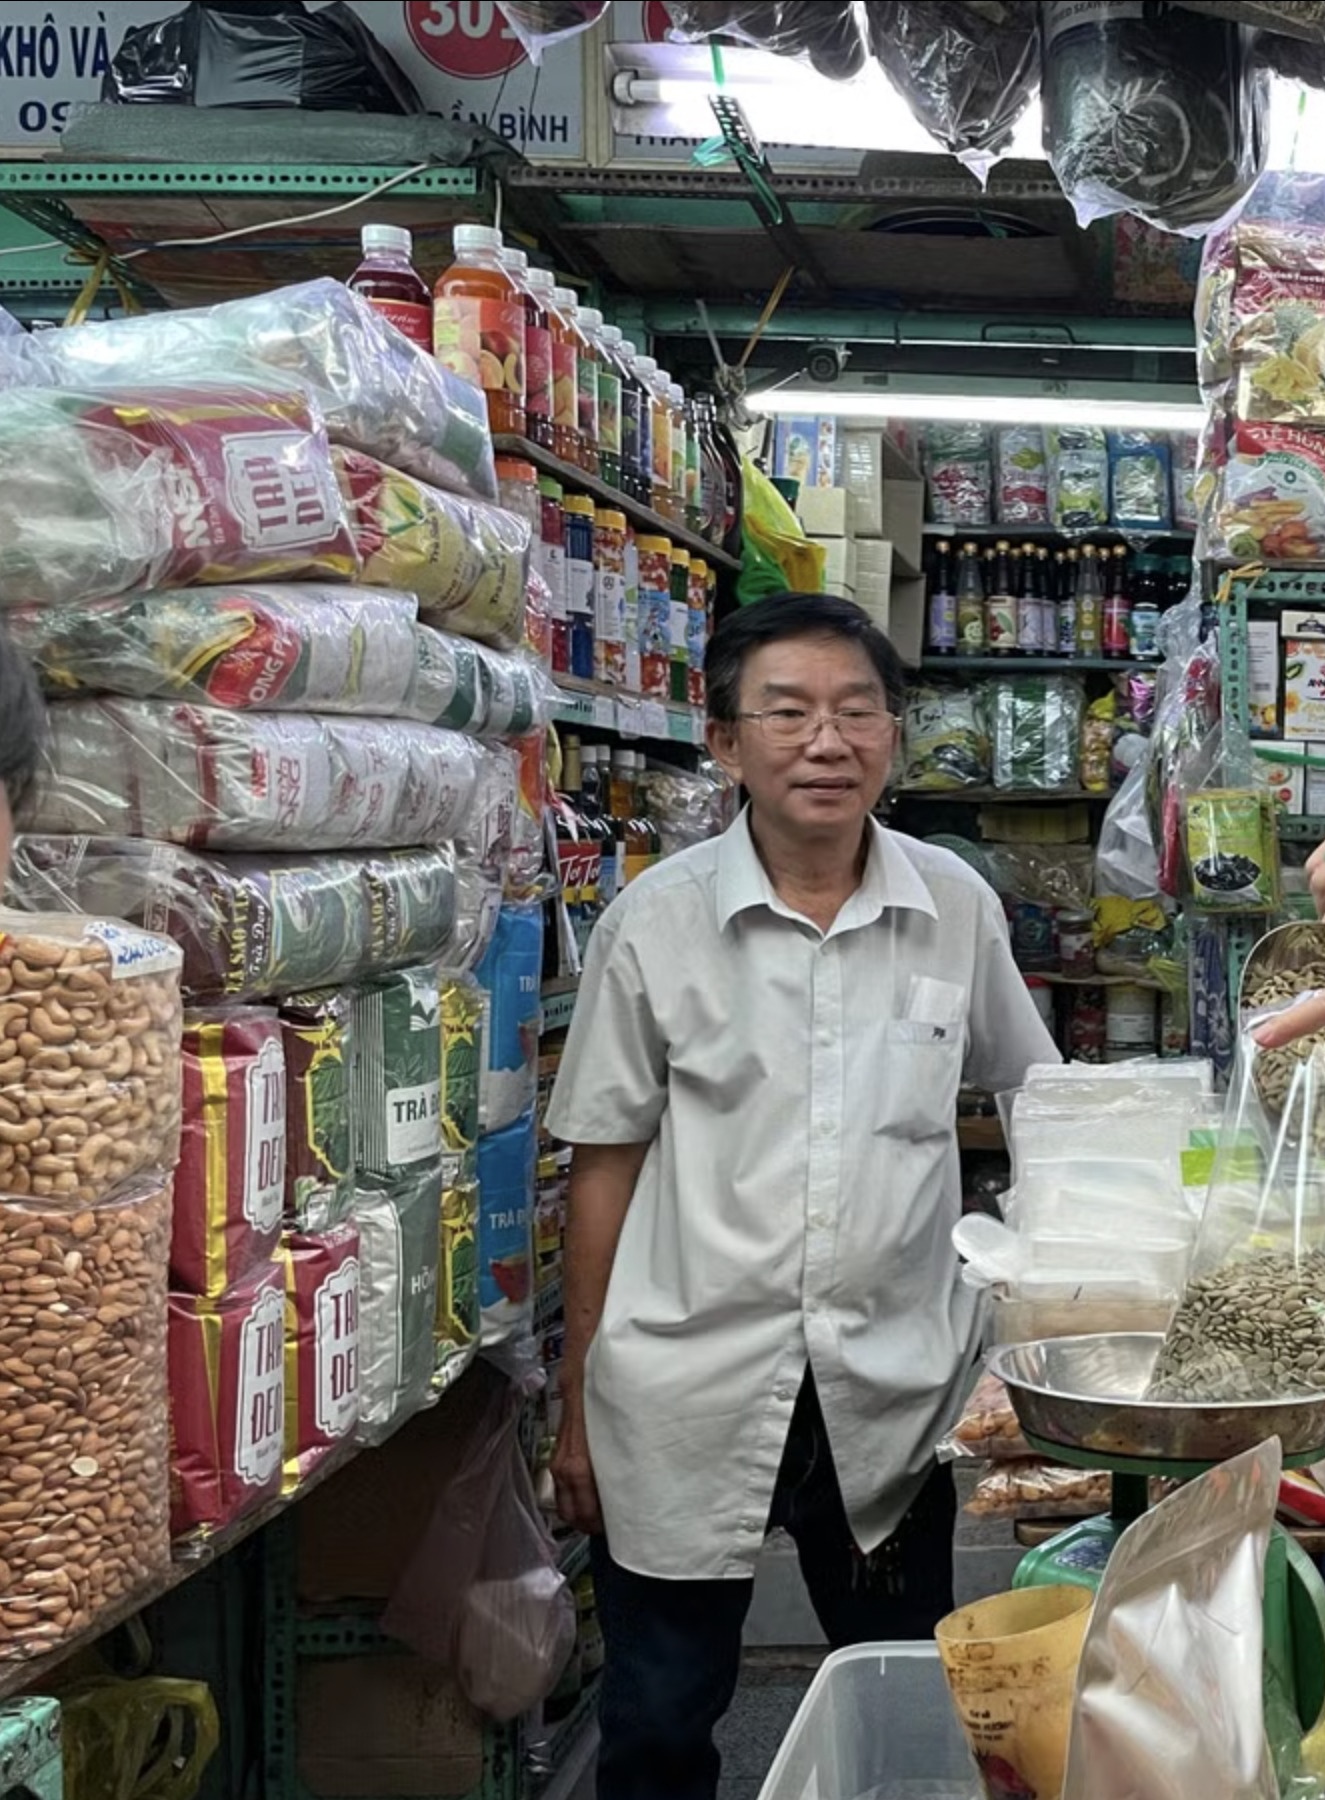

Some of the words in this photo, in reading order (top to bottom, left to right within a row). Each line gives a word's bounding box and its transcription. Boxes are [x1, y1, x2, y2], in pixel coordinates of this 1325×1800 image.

[418, 0, 522, 40] 30
[0, 13, 59, 78] KHÔ
[70, 10, 110, 78] VÀ
[500, 107, 569, 143] BÌNH
[393, 1091, 426, 1123] TRÀ
